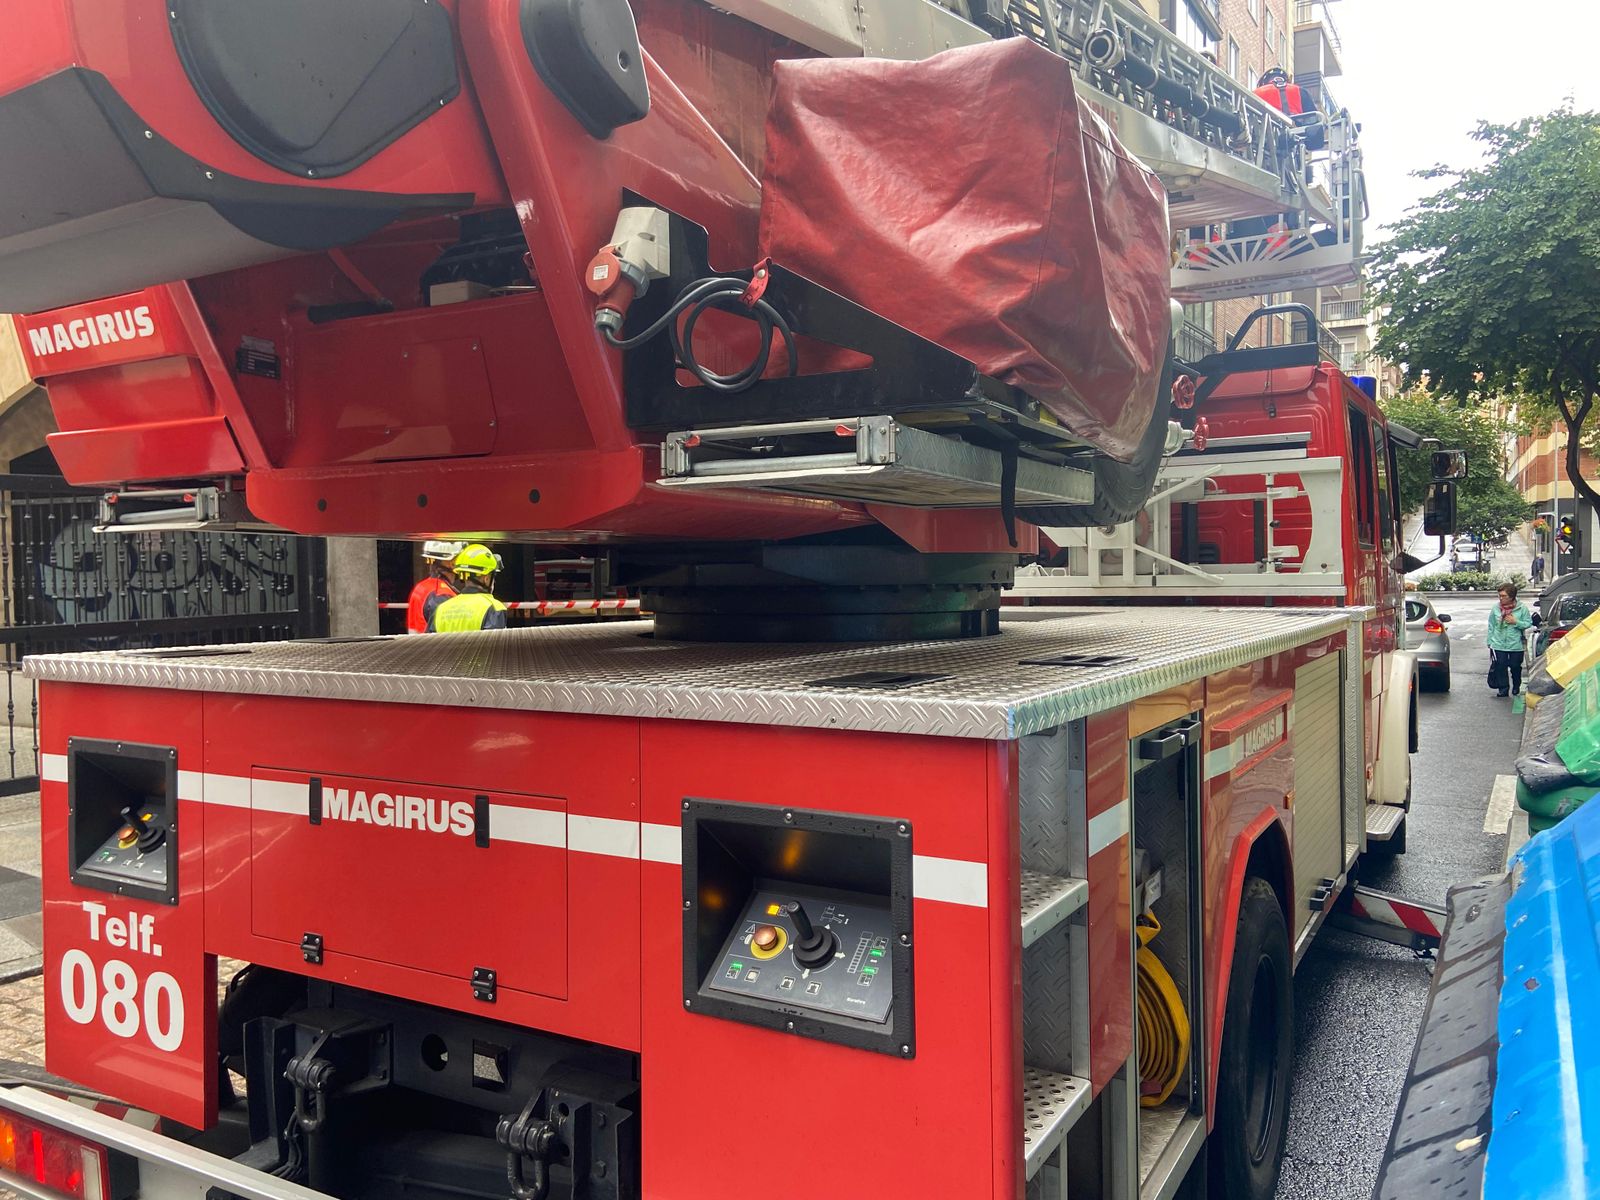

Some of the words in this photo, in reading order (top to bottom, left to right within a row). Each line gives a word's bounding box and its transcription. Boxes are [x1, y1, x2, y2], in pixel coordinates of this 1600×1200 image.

[28, 305, 155, 356] MAGIRUS
[1245, 717, 1276, 758] MAGIRUS
[322, 787, 476, 837] MAGIRUS
[82, 900, 163, 957] Telf.
[60, 948, 185, 1052] 080
